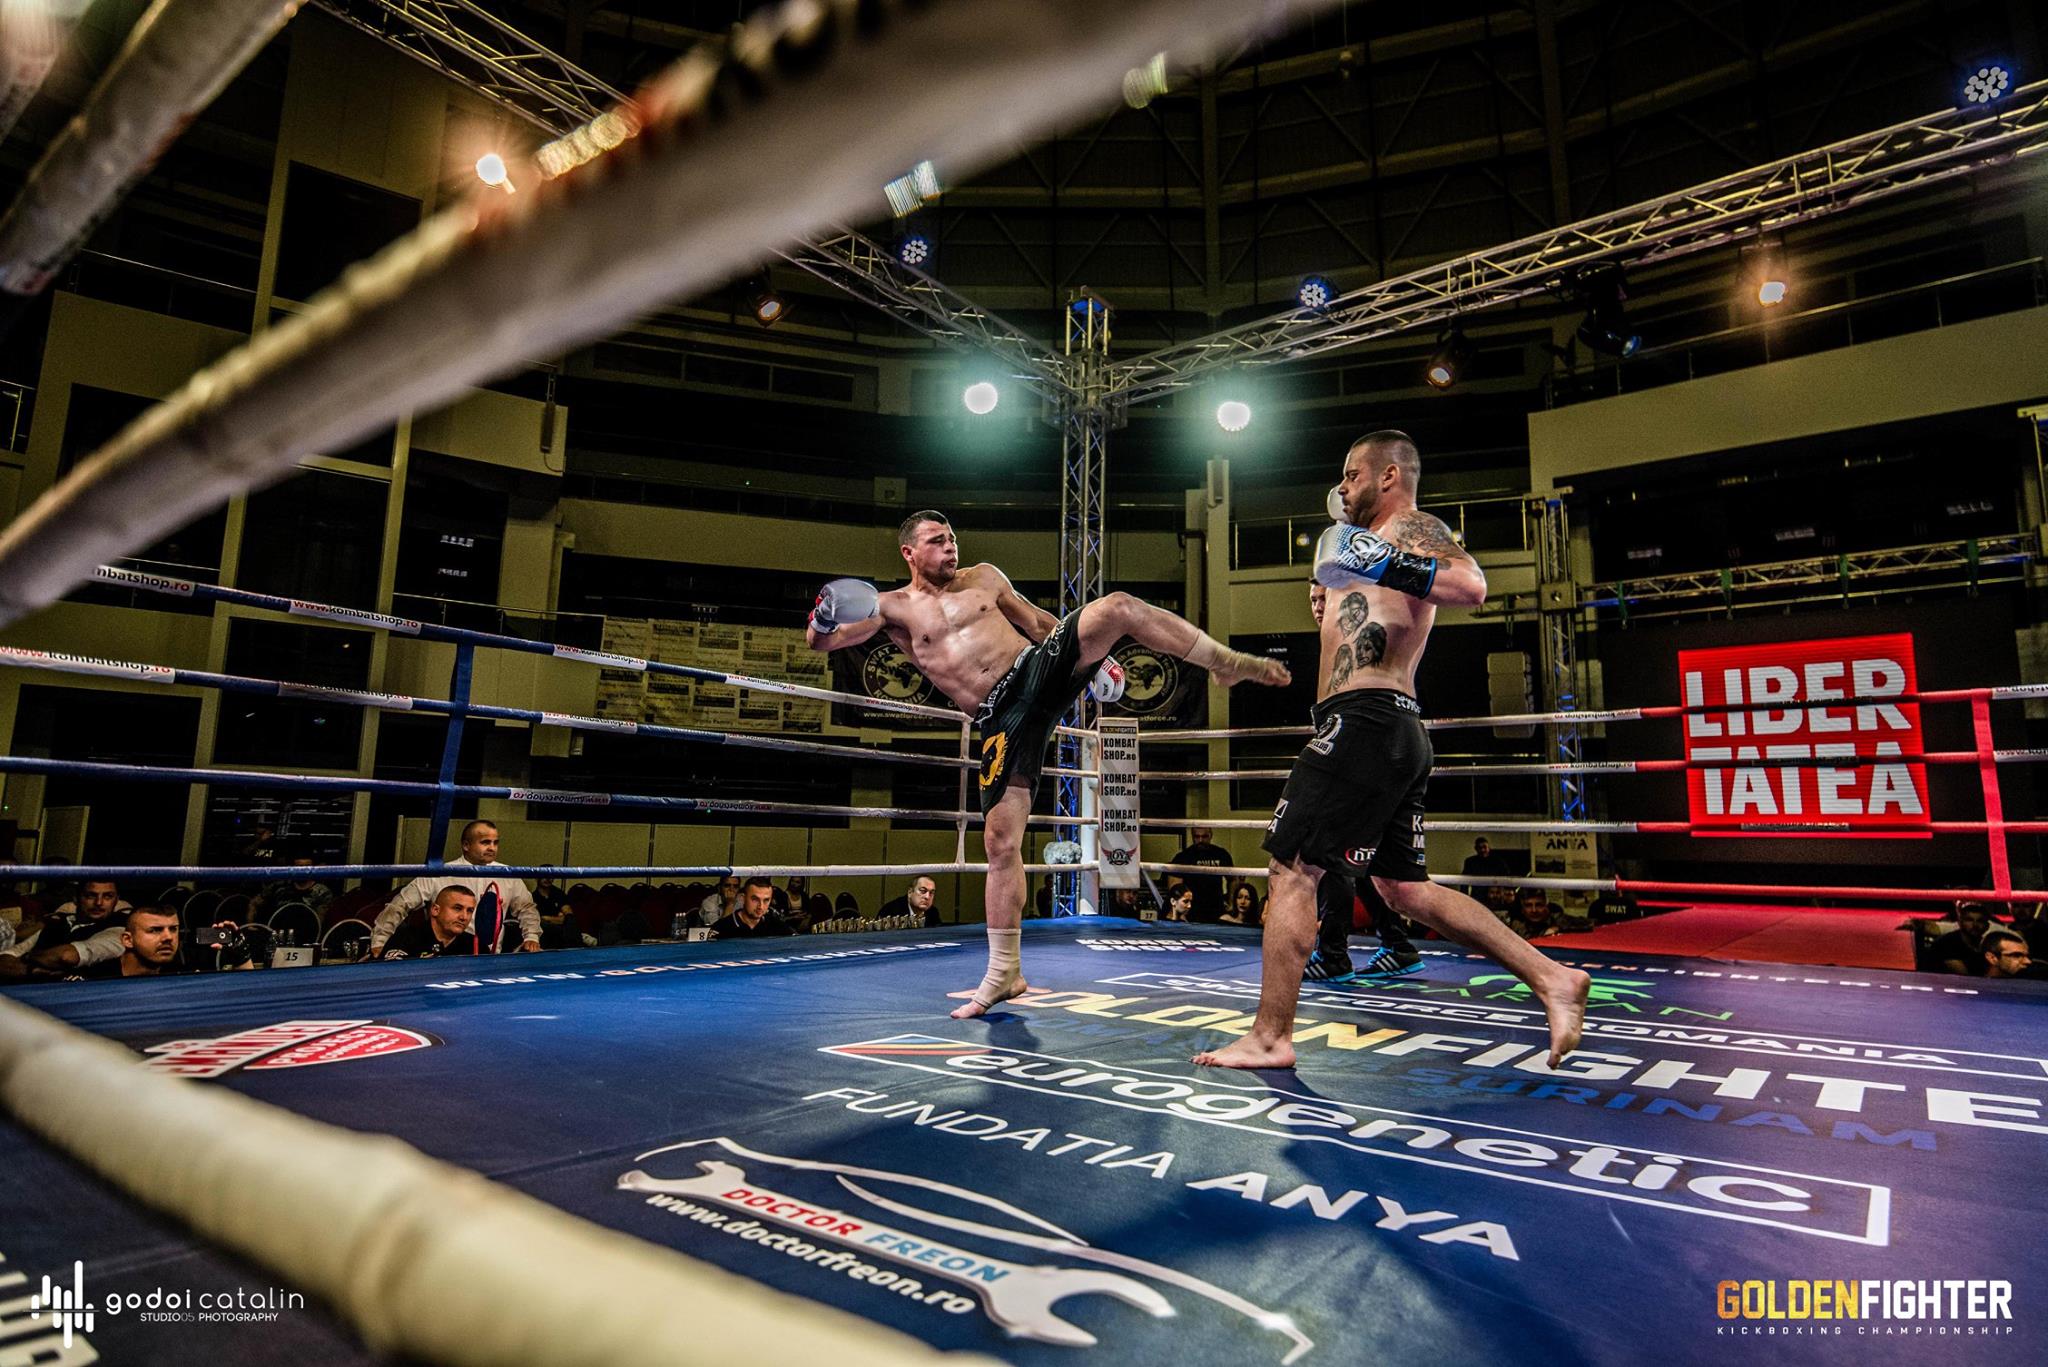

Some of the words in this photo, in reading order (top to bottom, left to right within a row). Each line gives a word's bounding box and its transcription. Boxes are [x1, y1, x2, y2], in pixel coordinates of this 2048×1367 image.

[294, 600, 418, 628] www.kombatshop.ro
[866, 646, 891, 673] SWAT
[1685, 658, 1912, 738] LIBER
[1104, 738, 1137, 747] KOMBAT
[1104, 774, 1137, 783] KOMBAT
[1690, 741, 1923, 815] TATEA
[1104, 810, 1137, 819] KOMBAT
[1604, 904, 1627, 914] SWAT
[699, 931, 706, 941] 8
[1075, 938, 1222, 946] KOMBAT
[285, 951, 298, 961] 15
[425, 942, 962, 990] WWW.GOLDENFIGHTER.RO
[1317, 994, 1529, 1024] FORCE
[945, 1054, 1811, 1212] eurogenetic
[802, 1087, 1176, 1180] FUNDATIA
[1186, 1171, 1520, 1261] ANYA
[721, 1187, 863, 1237] DOCTOR
[865, 1232, 1010, 1284] FREON
[646, 1193, 976, 1315] www.doctorfreon.ro
